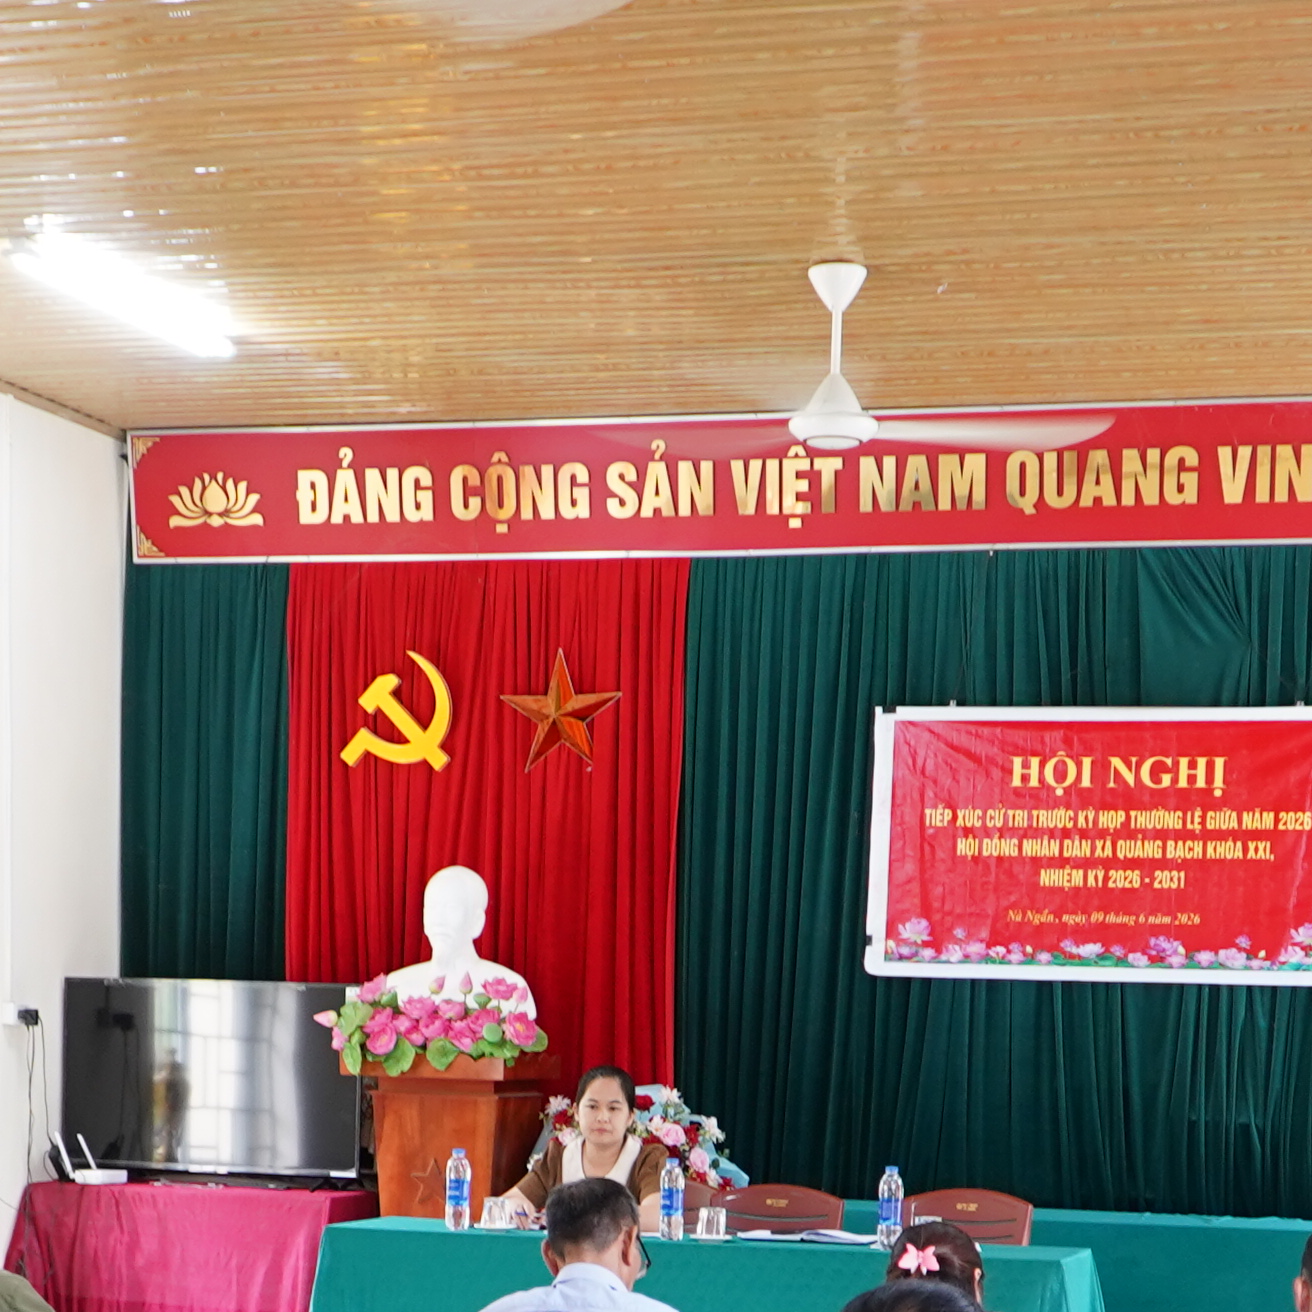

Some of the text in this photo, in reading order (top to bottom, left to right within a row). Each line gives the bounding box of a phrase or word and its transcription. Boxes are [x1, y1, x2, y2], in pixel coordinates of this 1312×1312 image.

[296, 446, 434, 524] ĐẢNG
[449, 450, 591, 533] CỘNG
[605, 438, 714, 520] SẢN
[730, 443, 844, 529] VIỆT
[859, 453, 987, 513] NAM
[1005, 444, 1200, 515] QUANG
[1010, 750, 1227, 797] HỘI NGHỊ
[924, 803, 1312, 834] TIẾP XÚC CỬ TRI TRƯỚC KỲ HỌP THƯỜNG LỆ GIỮA NĂM 2026
[956, 832, 1275, 863] HỘI ĐỒNG NHÂN DÂN XÃ QUẢNG BẠCH KHÓA XXI,
[1040, 864, 1084, 891] NHIỆM
[1087, 865, 1105, 887] KỲ
[1108, 869, 1141, 888] 2026
[1153, 870, 1186, 889] 2031
[1061, 911, 1088, 927] ngày
[1090, 910, 1104, 923] 09
[1105, 911, 1136, 927] tháng
[1138, 911, 1146, 923] 6
[1148, 911, 1172, 925] năm
[1174, 912, 1201, 925] 2026
